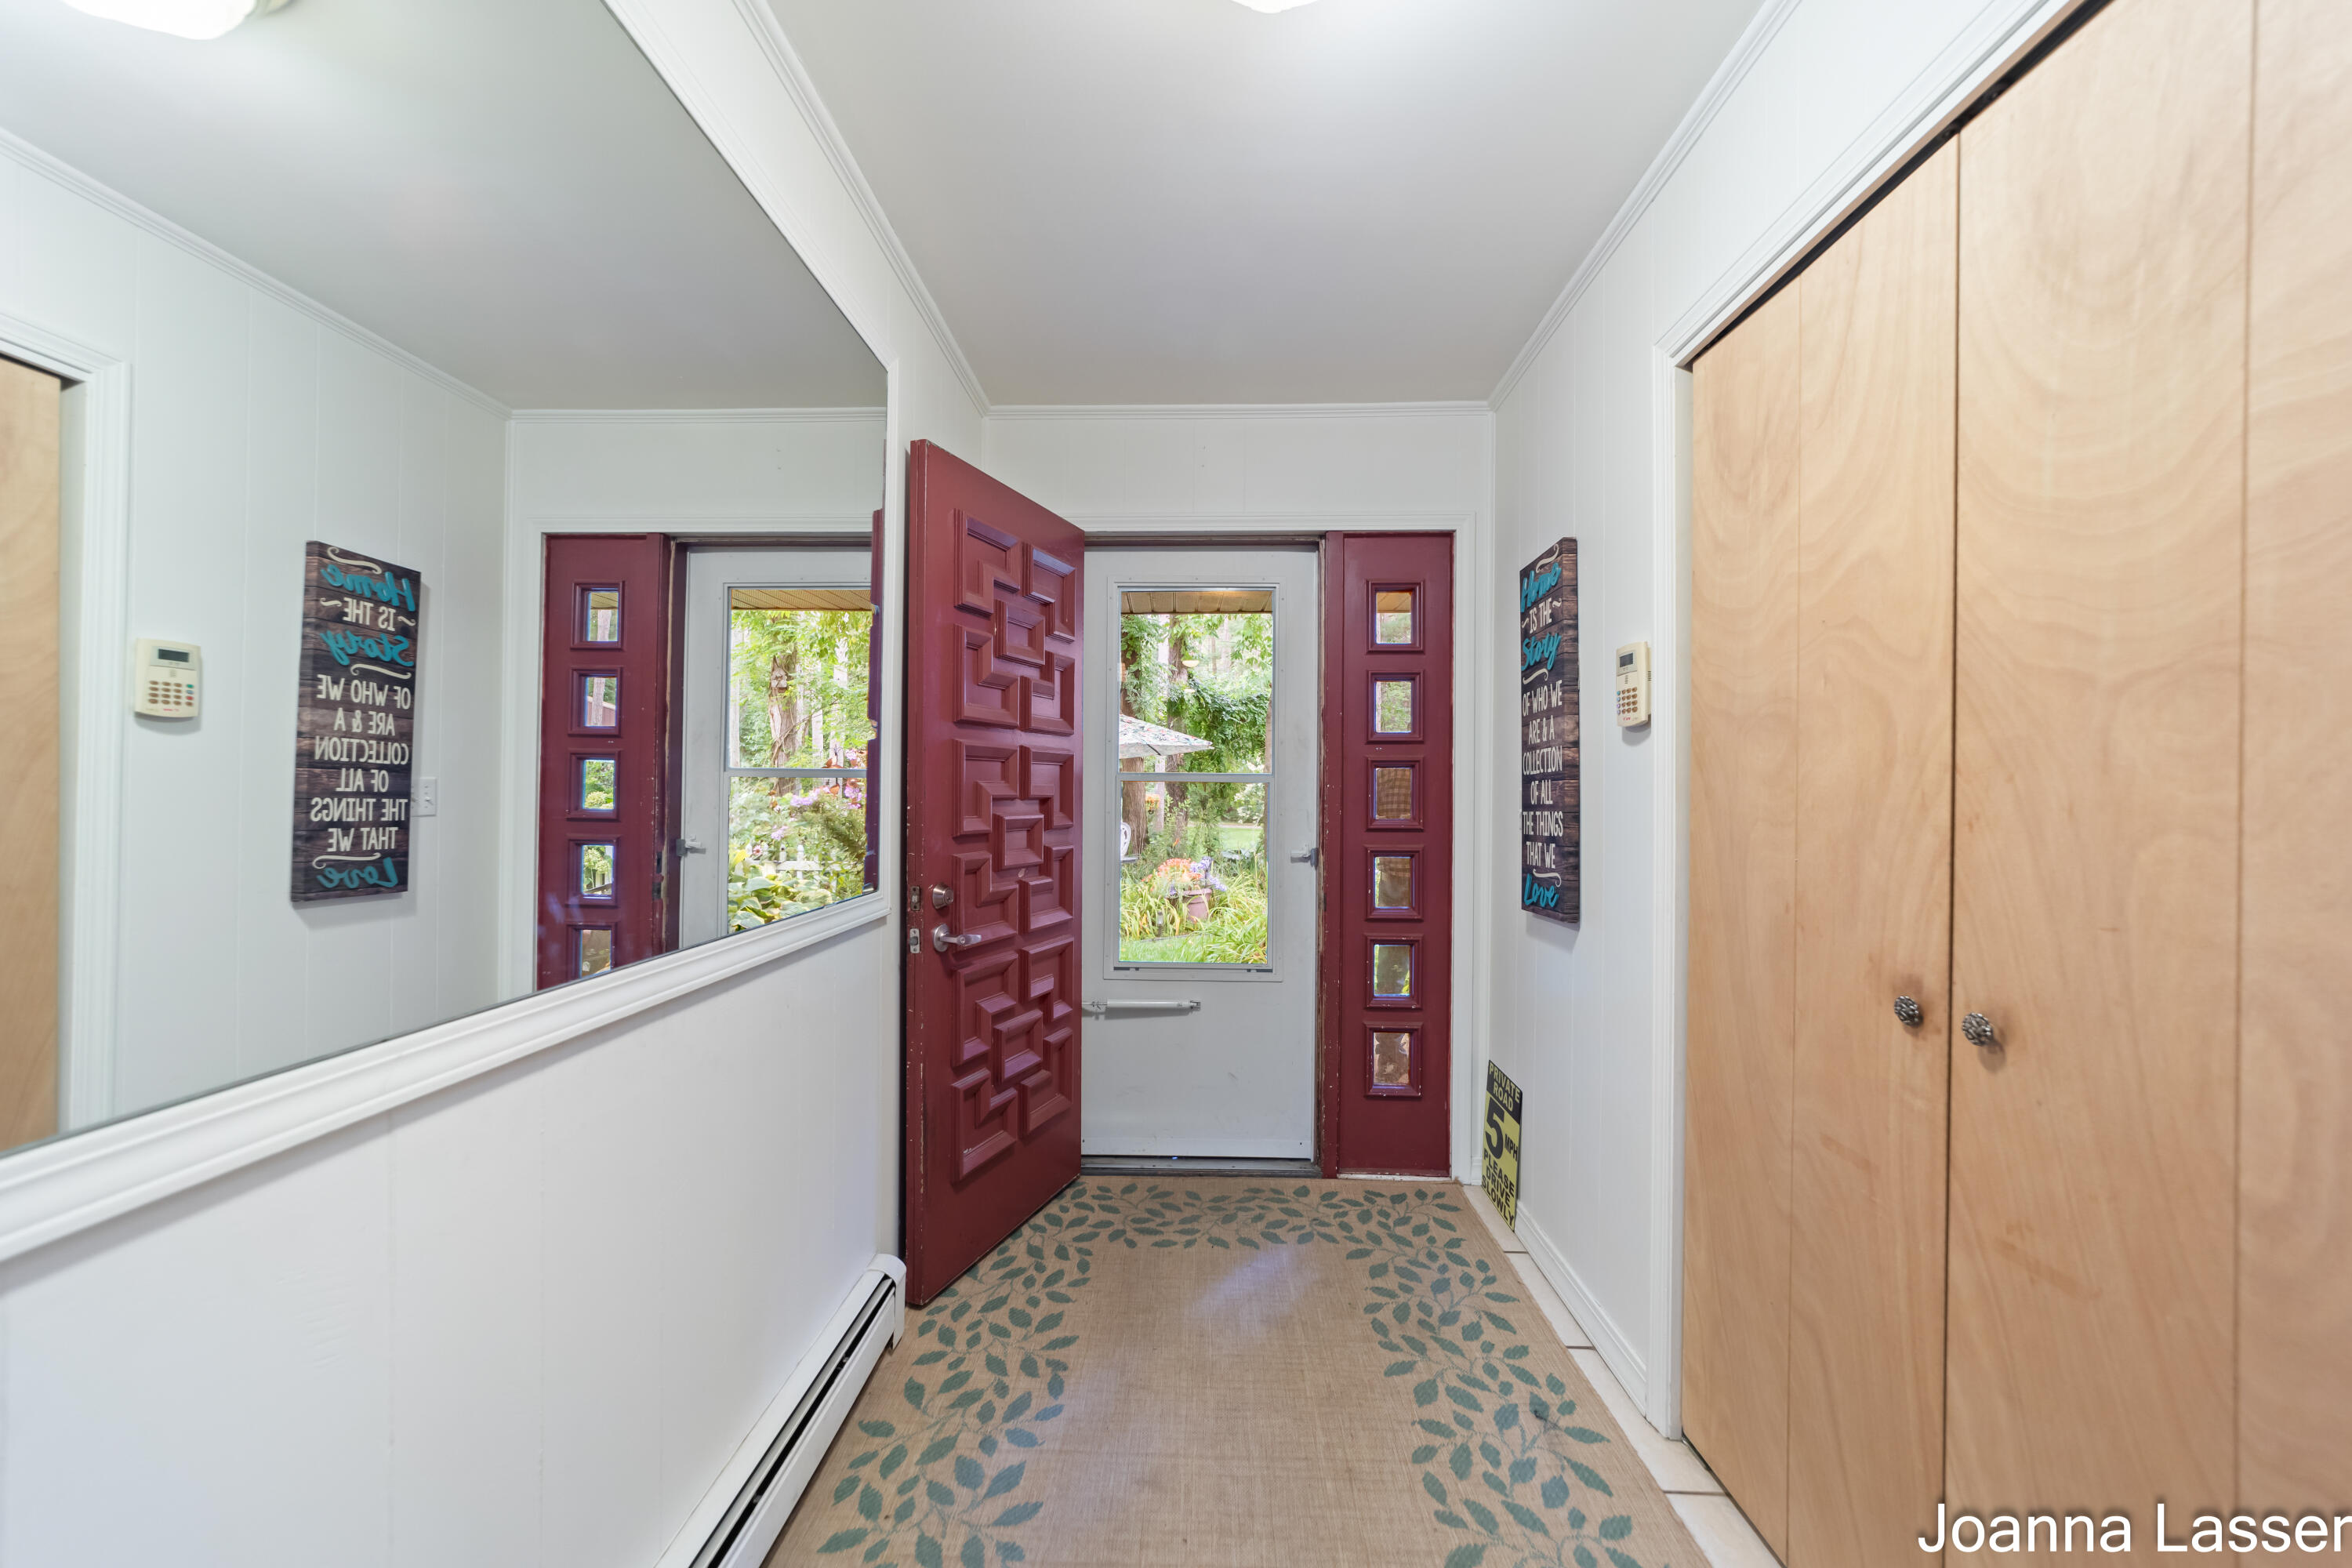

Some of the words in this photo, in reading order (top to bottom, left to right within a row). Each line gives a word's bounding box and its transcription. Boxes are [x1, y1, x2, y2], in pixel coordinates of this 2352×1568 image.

[1520, 562, 1562, 612] Home
[1529, 608, 1538, 633] IS
[1539, 597, 1552, 627] THE
[1521, 633, 1562, 671] Story
[1522, 691, 1530, 717] OF
[1531, 684, 1548, 714] WHO
[1550, 680, 1563, 708] WE
[1529, 717, 1541, 745] ARE
[1542, 717, 1548, 742] &
[1549, 714, 1555, 740] A
[1523, 746, 1563, 775] COLLECTION
[1530, 780, 1539, 804] OF
[1541, 779, 1553, 804] ALL
[1523, 811, 1534, 835] THE
[1535, 811, 1563, 837] THINGS
[1526, 841, 1542, 867] THAT
[1544, 843, 1555, 869] WE
[1523, 873, 1559, 907] Love
[1490, 1062, 1520, 1103] PRIVATE
[1493, 1081, 1513, 1112] ROAD
[1485, 1096, 1504, 1159] 5
[1504, 1133, 1518, 1162] MPH
[1483, 1148, 1515, 1198] PLEASE
[1486, 1165, 1511, 1207] DRIVE
[1482, 1174, 1514, 1226] SLOWLY
